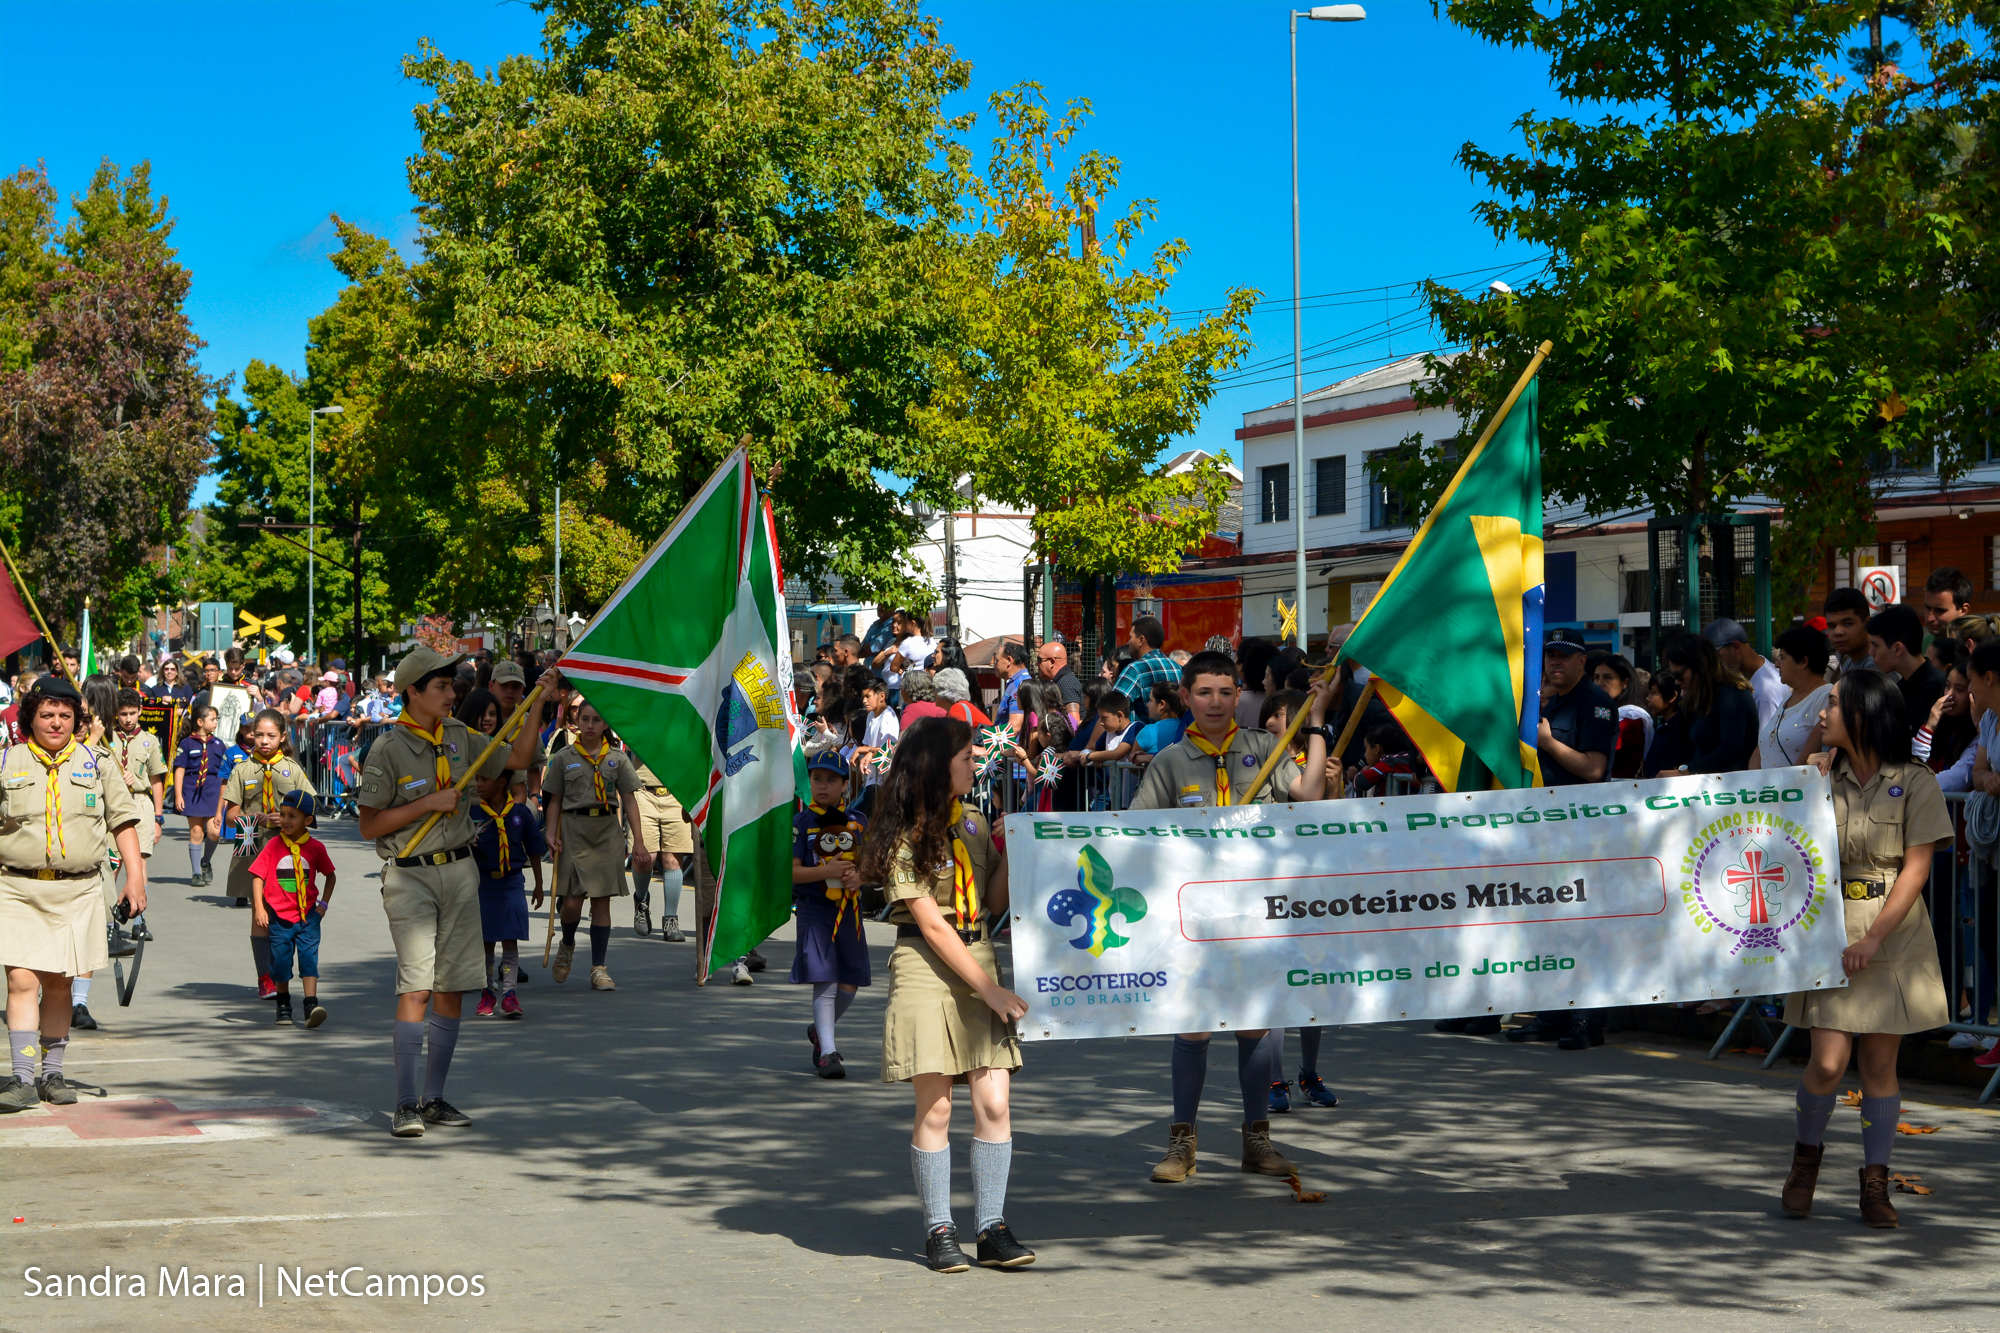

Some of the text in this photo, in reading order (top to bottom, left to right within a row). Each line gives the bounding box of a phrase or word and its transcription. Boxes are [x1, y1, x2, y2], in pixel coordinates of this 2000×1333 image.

[728, 752, 749, 774] 1934
[1034, 786, 1804, 840] Escotismo com Propósito Cristão
[1730, 827, 1773, 838] JESUS
[1680, 810, 1826, 934] GRUPO ESCOTEIRO EVANGÉLICO MIKAEL
[1264, 878, 1587, 921] Escoteiros Mikael
[1036, 970, 1168, 993] ESCOTEIROS
[1287, 955, 1576, 987] Campos do Jordão
[1051, 992, 1151, 1007] DO BRASIL
